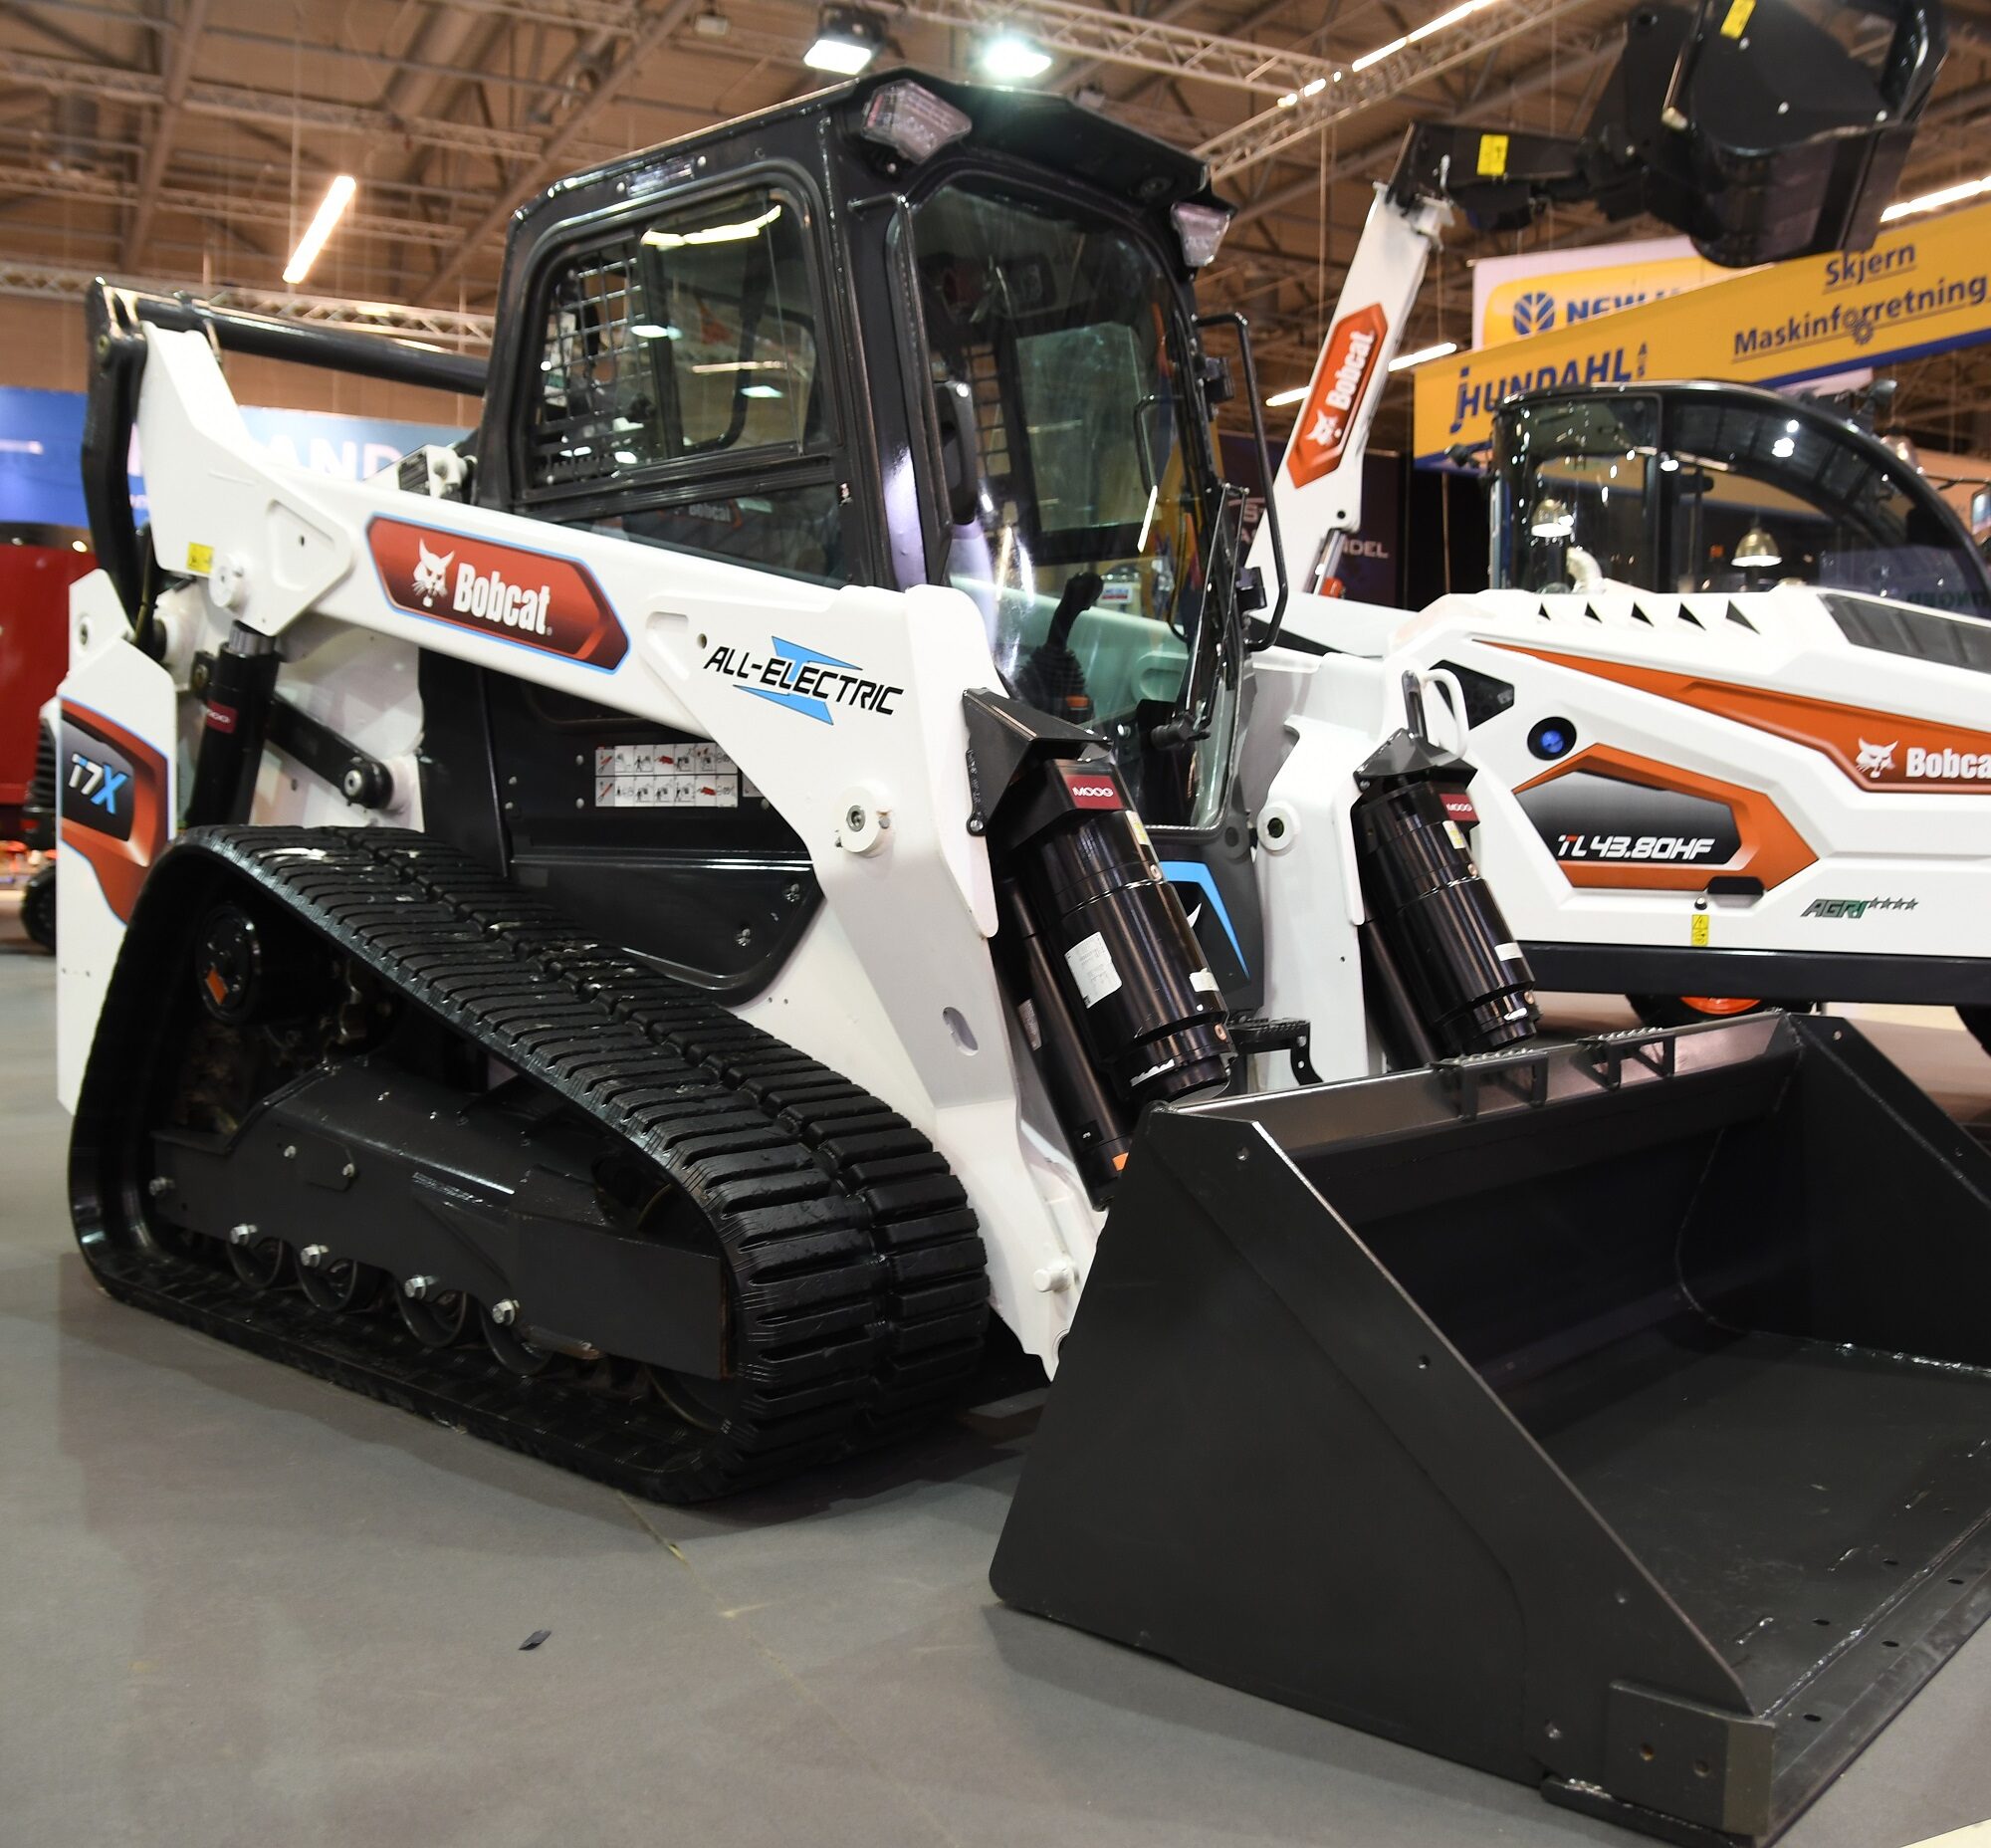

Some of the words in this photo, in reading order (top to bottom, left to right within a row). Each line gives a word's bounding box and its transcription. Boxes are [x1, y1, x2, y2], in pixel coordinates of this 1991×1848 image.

[1825, 244, 1915, 286] Skjern
[1734, 275, 1987, 355] Maskinforretning
[1325, 330, 1376, 411] Bobcat
[452, 562, 551, 635] Bobcat
[703, 645, 905, 716] ALL-ELECTRIC
[68, 753, 128, 814] T7X
[1071, 787, 1114, 798] MOOG
[1445, 803, 1473, 812] MOOG
[1800, 898, 1870, 919] AGRI
